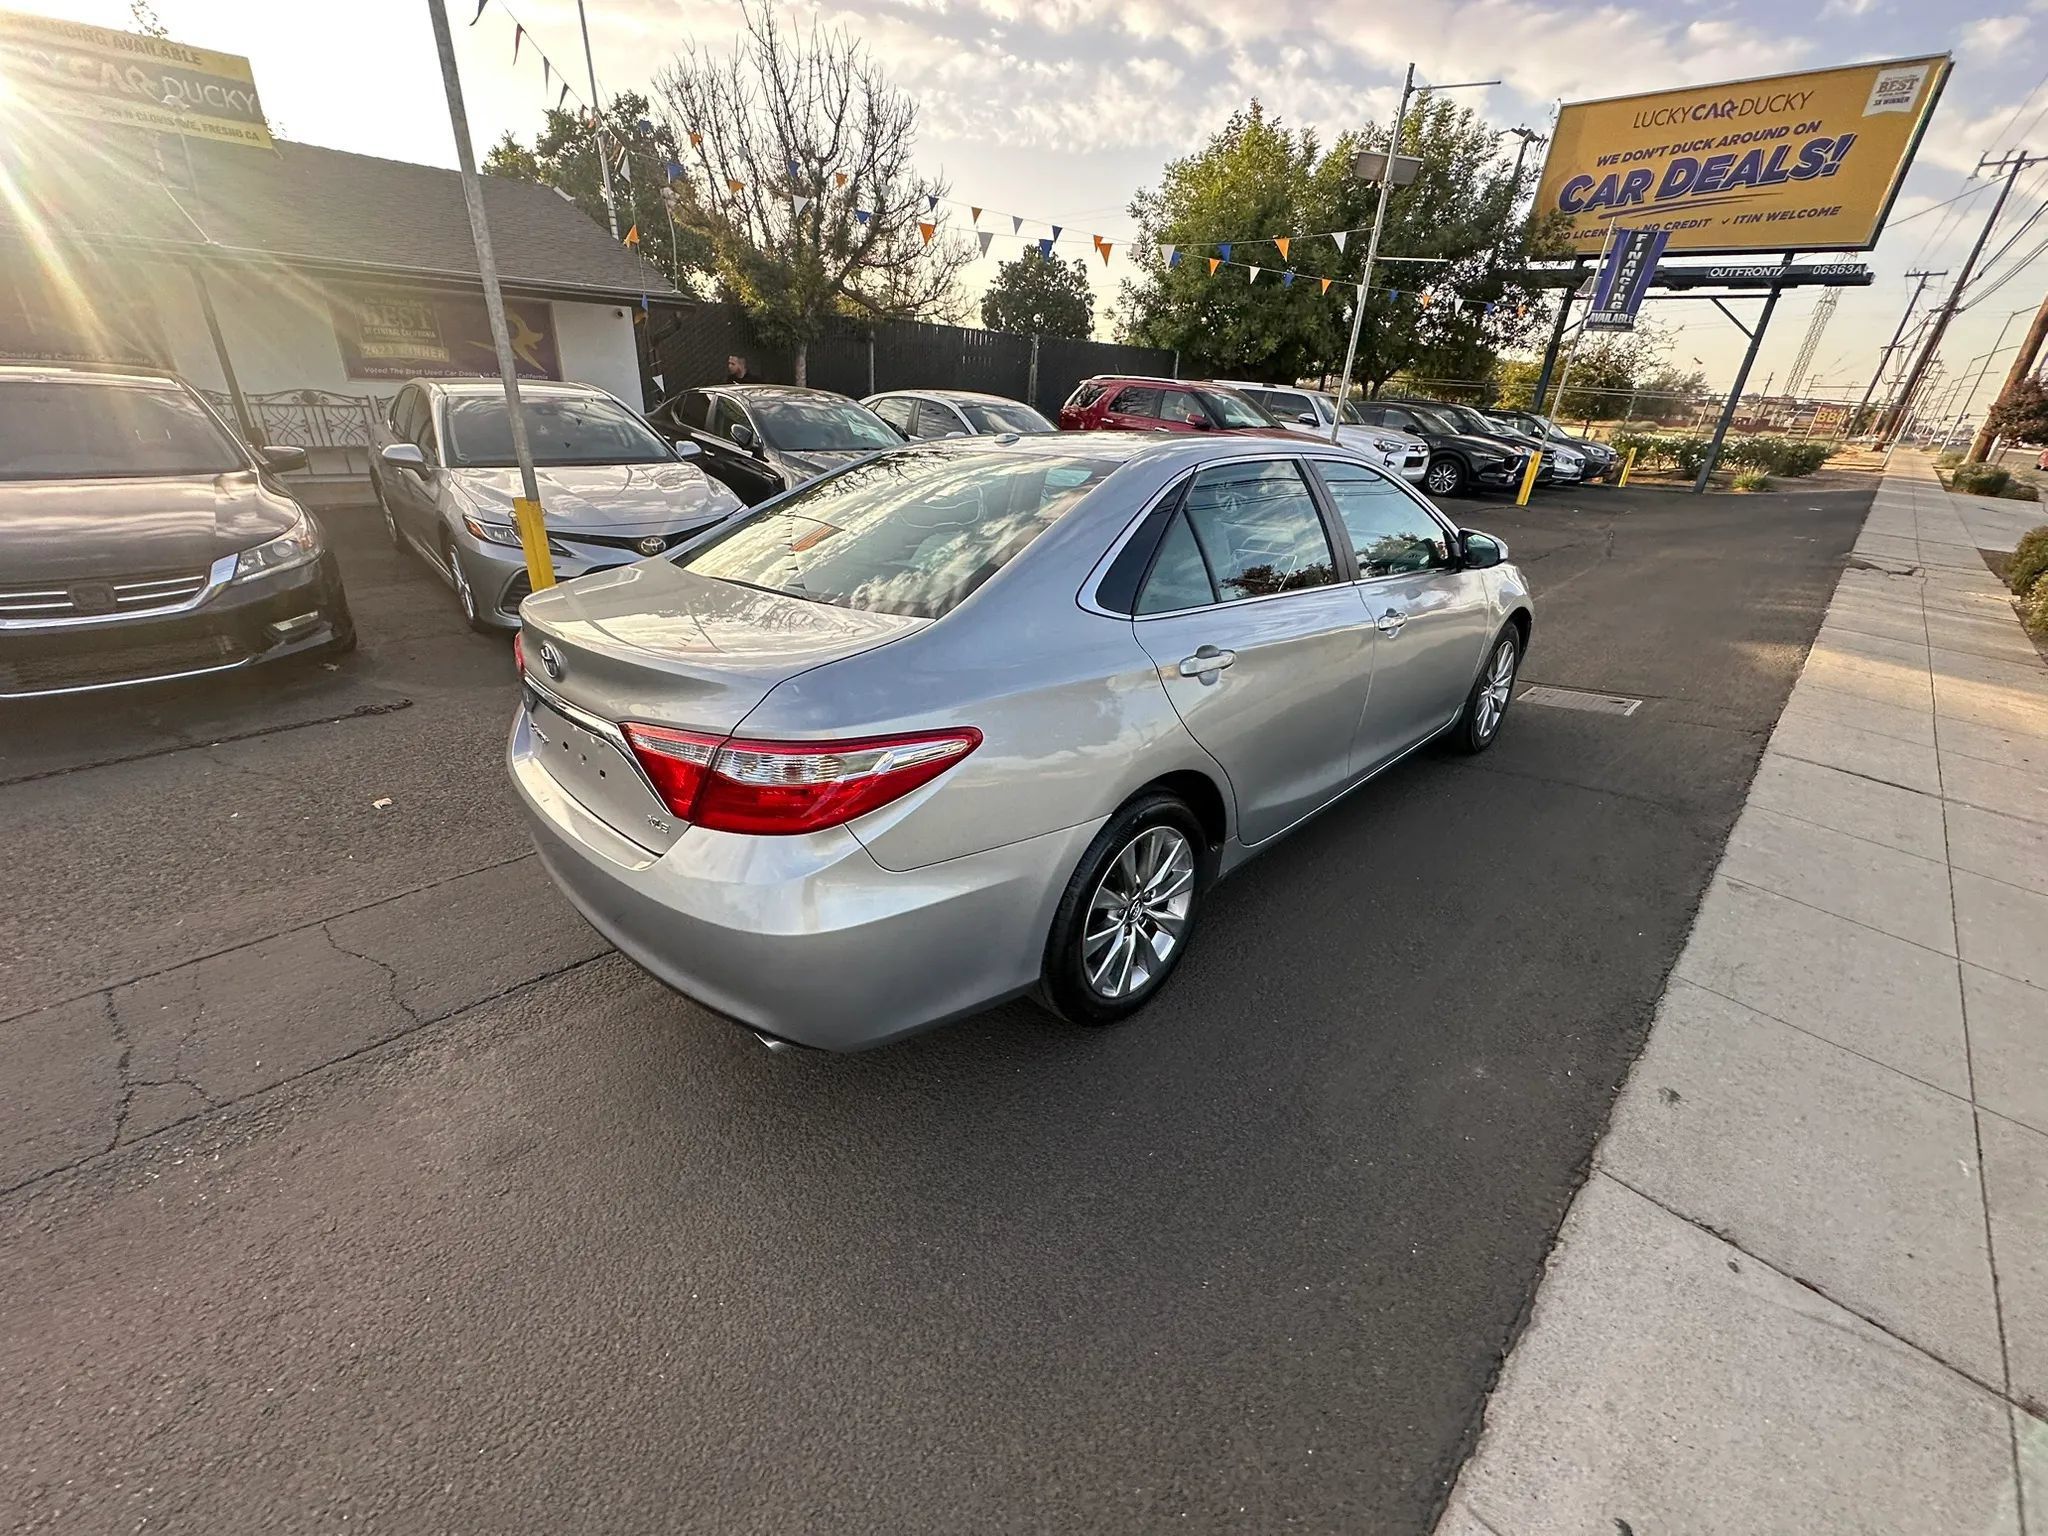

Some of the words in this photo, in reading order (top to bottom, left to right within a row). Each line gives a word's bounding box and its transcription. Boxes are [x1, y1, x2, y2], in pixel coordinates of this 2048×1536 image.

[1876, 77, 1920, 94] BEST
[201, 123, 244, 138] FRESNO
[245, 131, 260, 141] CA
[1597, 154, 1621, 168] WE
[1621, 145, 1670, 163] DON'T
[1669, 138, 1715, 155] DUCK
[1716, 126, 1790, 149] AROUND
[1793, 120, 1822, 136] ON
[1558, 168, 1655, 215] CAR
[1654, 133, 1858, 202] DEALS!
[1643, 223, 1660, 231] NO
[1663, 218, 1712, 231] CREDIT
[1733, 213, 1761, 225] ITIN
[1765, 206, 1842, 222] WELCOME
[1610, 233, 1649, 310] FINANCING
[1812, 264, 1862, 275] 06363A
[1589, 312, 1634, 324] AVAILABLE
